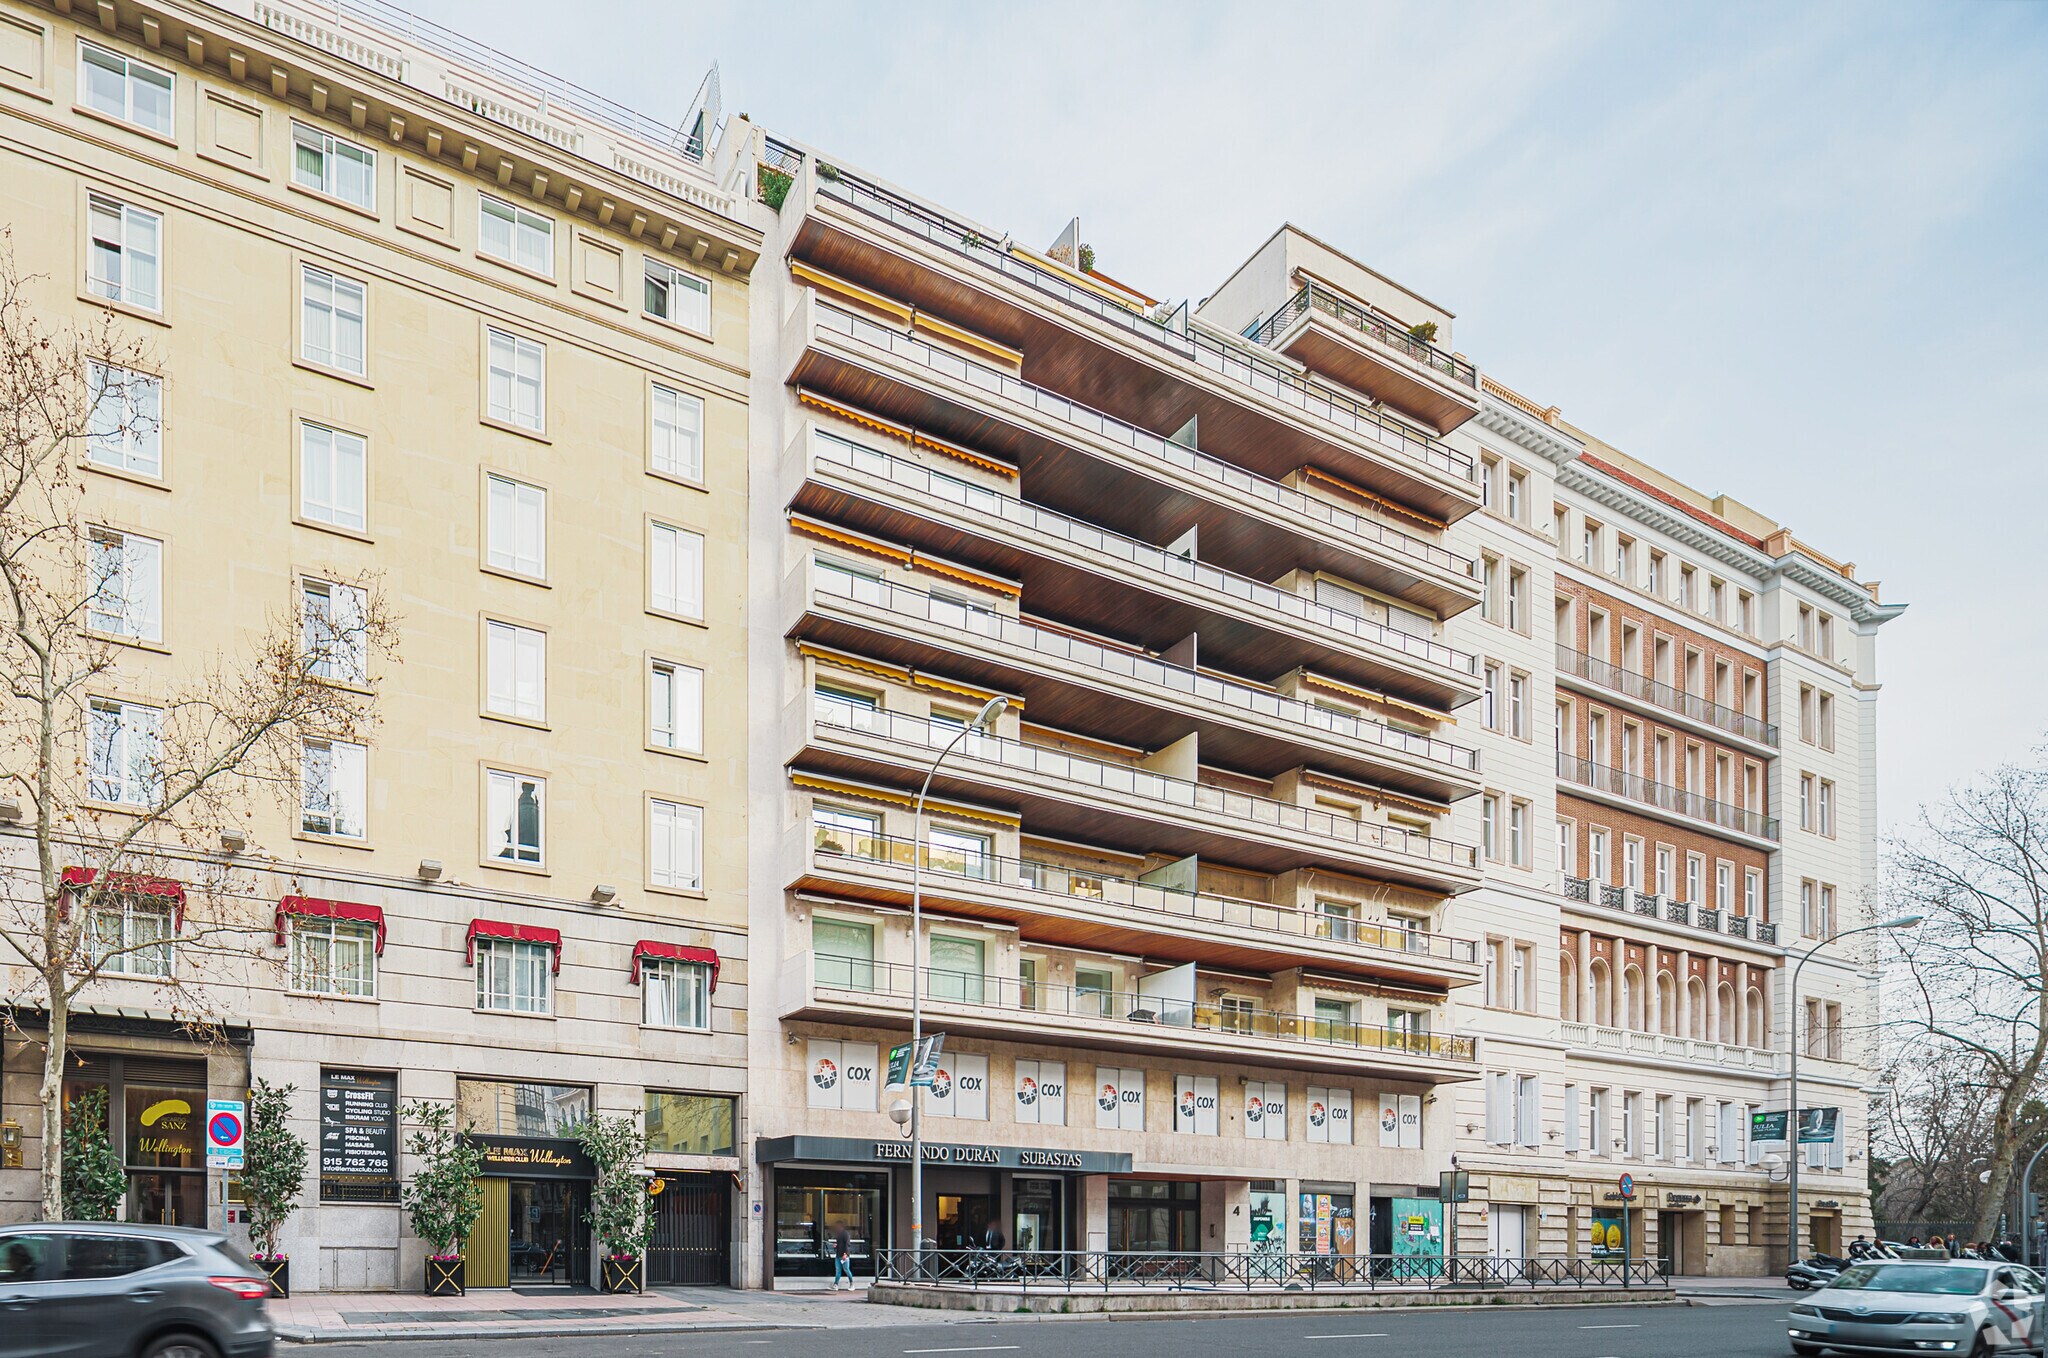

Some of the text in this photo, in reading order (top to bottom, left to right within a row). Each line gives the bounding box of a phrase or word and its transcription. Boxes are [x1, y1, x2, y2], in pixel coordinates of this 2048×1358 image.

[847, 1066, 871, 1081] COX
[960, 1077, 982, 1090] COX
[345, 1090, 374, 1100] CrossFit
[1041, 1084, 1062, 1097] COX
[1122, 1091, 1141, 1103] COX
[1196, 1097, 1215, 1109] COX
[1266, 1103, 1284, 1115] COX
[1332, 1108, 1348, 1120] COX
[161, 1121, 187, 1130] SANZ
[1402, 1114, 1417, 1125] COX
[140, 1138, 192, 1157] Wellington
[503, 1147, 528, 1156] MAX
[530, 1148, 572, 1167] Wellington
[876, 1143, 1083, 1167] FERNNDO DURÁN SUBASTAS
[323, 1157, 389, 1167] 915 762 766
[323, 1165, 388, 1173] info@lemaxclub.com
[1232, 1205, 1240, 1216] 4
